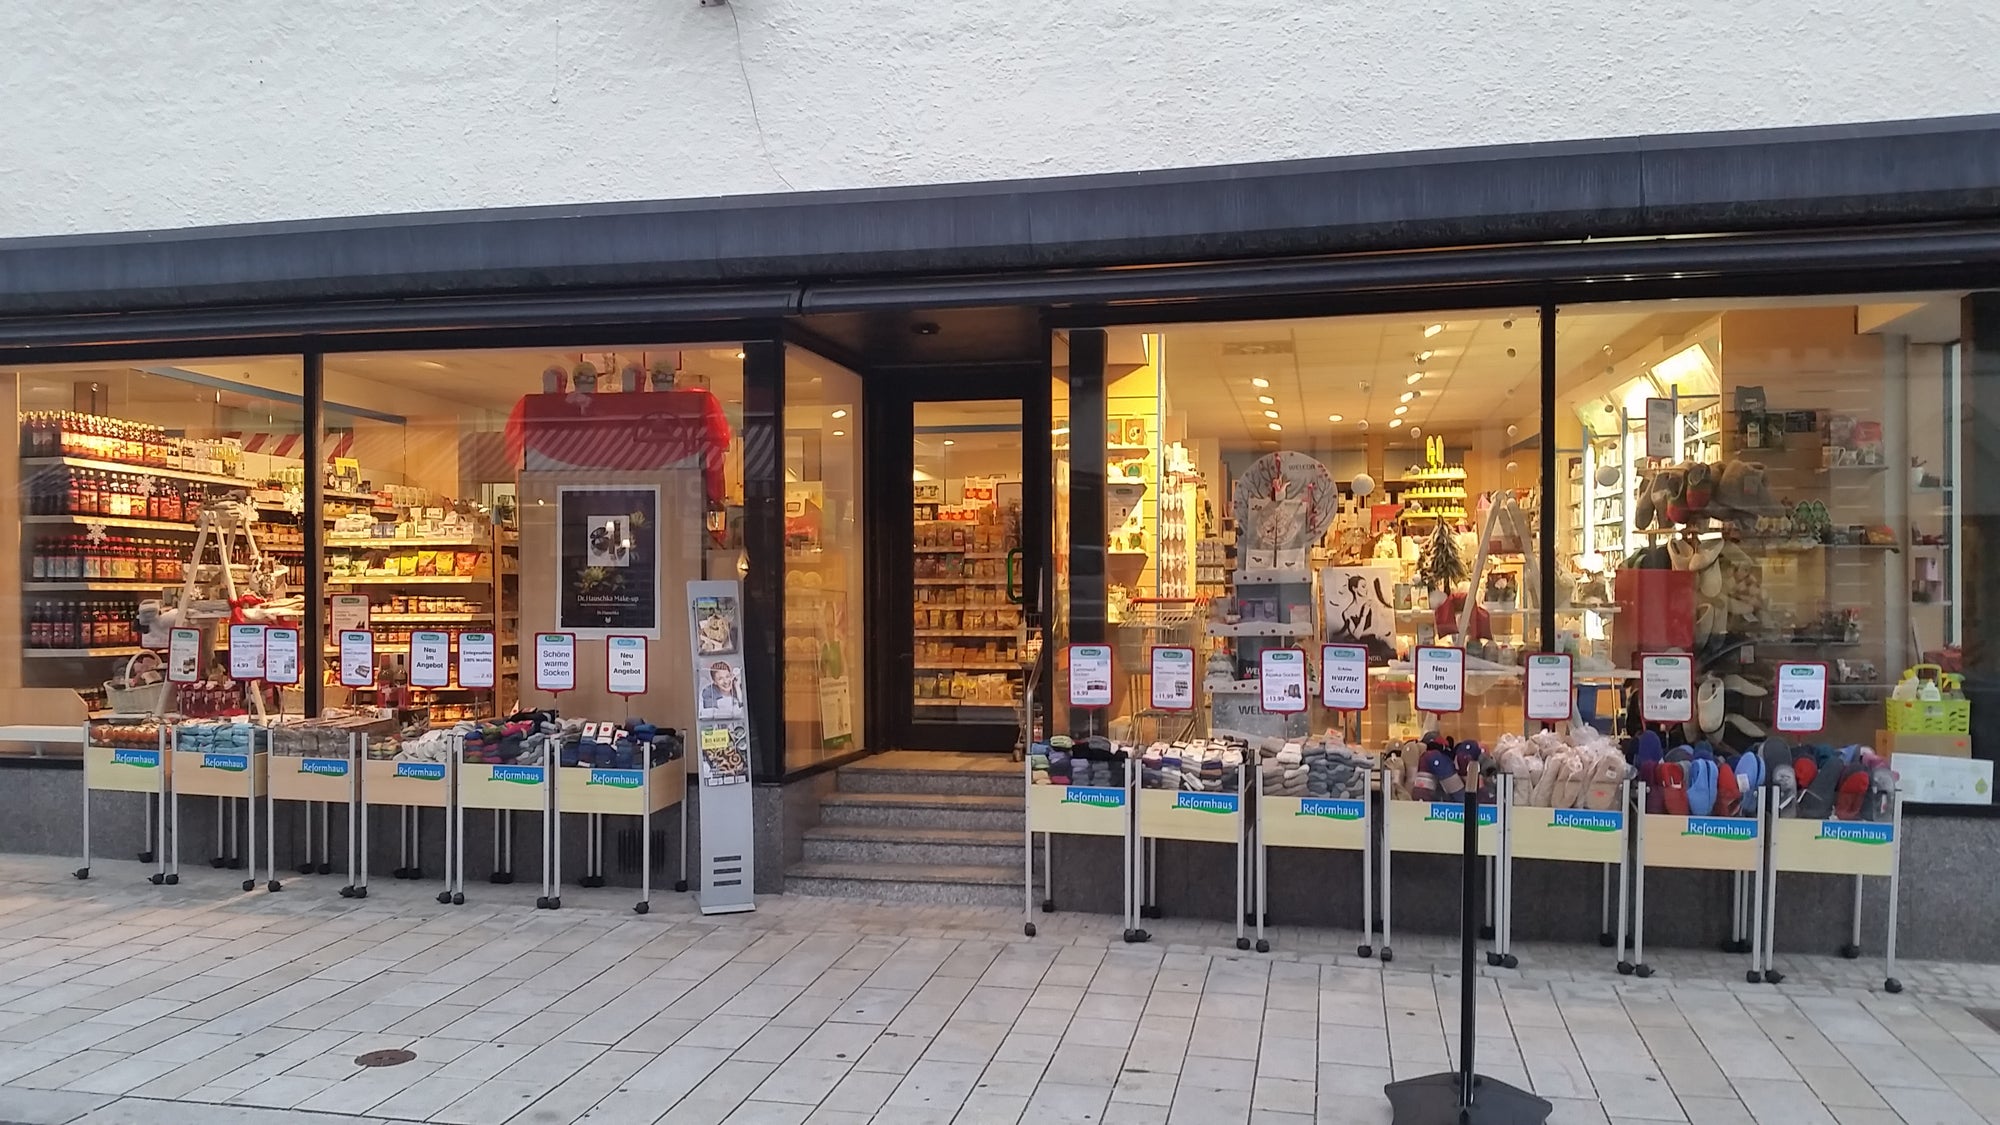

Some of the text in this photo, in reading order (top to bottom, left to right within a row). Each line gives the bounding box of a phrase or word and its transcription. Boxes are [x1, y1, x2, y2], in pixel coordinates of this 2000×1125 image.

[614, 595, 640, 603] Make-up
[543, 650, 571, 658] Schöne
[416, 662, 444, 670] Angebot
[1432, 665, 1448, 673] Neu
[543, 669, 570, 677] Socken
[1330, 685, 1360, 694] Socken
[1423, 682, 1456, 692] Angebot
[116, 753, 155, 765] Reformhaus
[205, 757, 244, 768] Reformhaus
[303, 763, 344, 774] Reformhaus
[398, 766, 441, 778] Reformhaus
[494, 770, 539, 782] Reformhaus
[592, 774, 639, 786] Reformhaus
[1068, 791, 1120, 804] Reformhaus
[1179, 797, 1233, 810] Reformhaus
[1303, 803, 1359, 817] Reformhaus
[1555, 814, 1617, 829] Reformhaus
[1690, 822, 1752, 836] Reformhaus
[1823, 826, 1887, 840] Reformhaus
